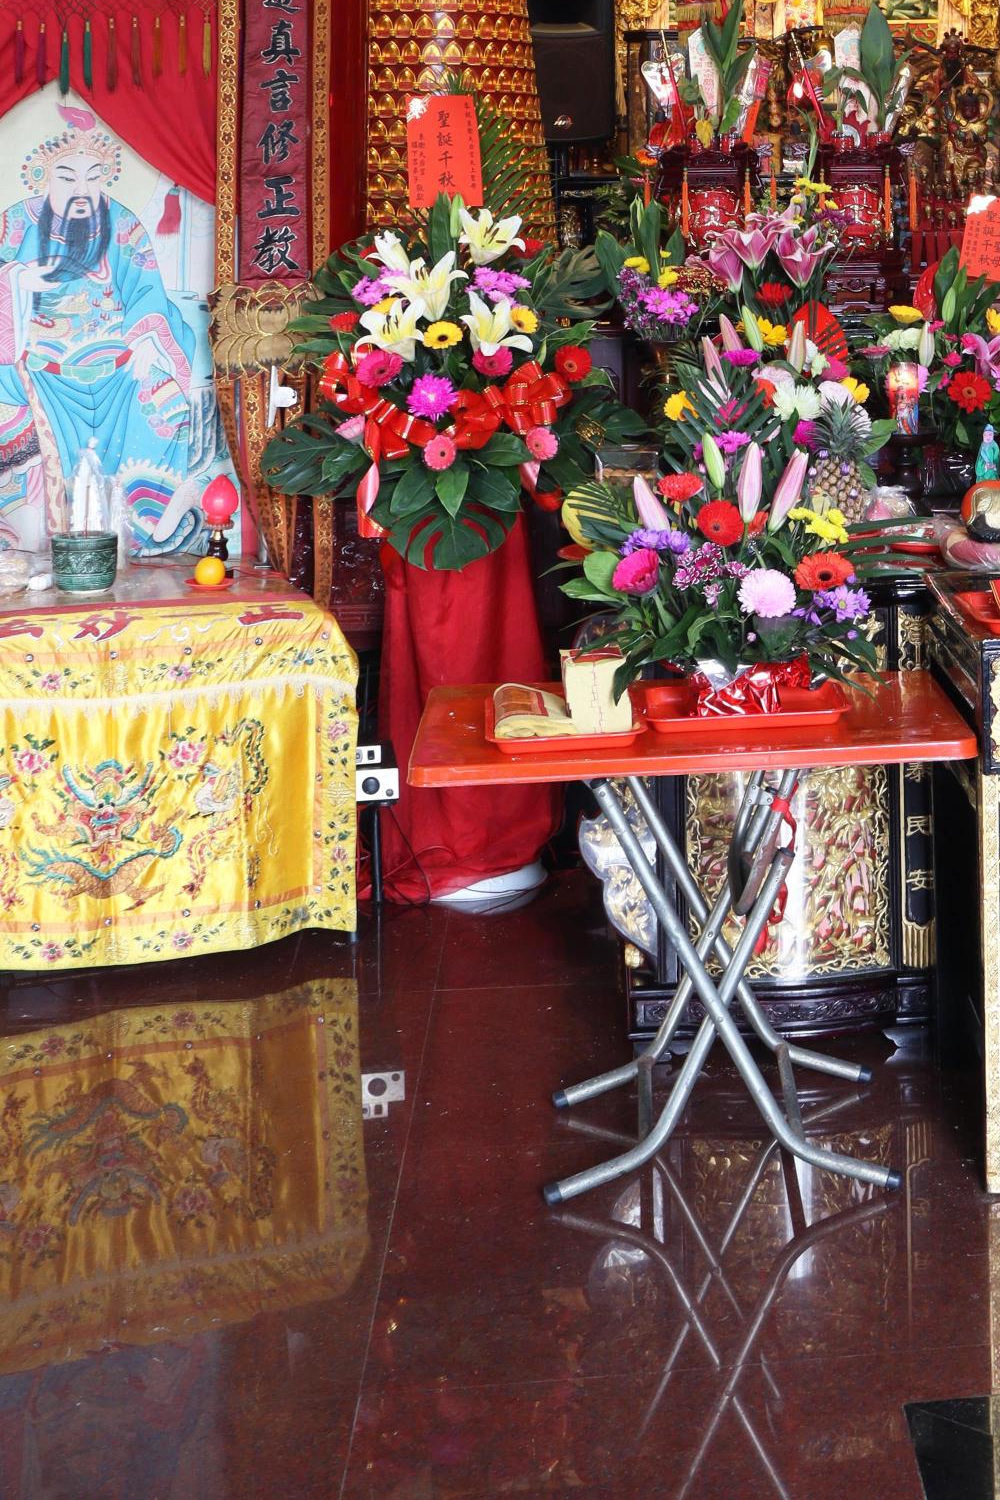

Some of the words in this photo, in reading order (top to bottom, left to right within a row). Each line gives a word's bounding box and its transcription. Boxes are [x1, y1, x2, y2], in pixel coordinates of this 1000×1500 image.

[436, 109, 457, 188] 聖誕千秋
[978, 210, 998, 267] 聖誕千秋
